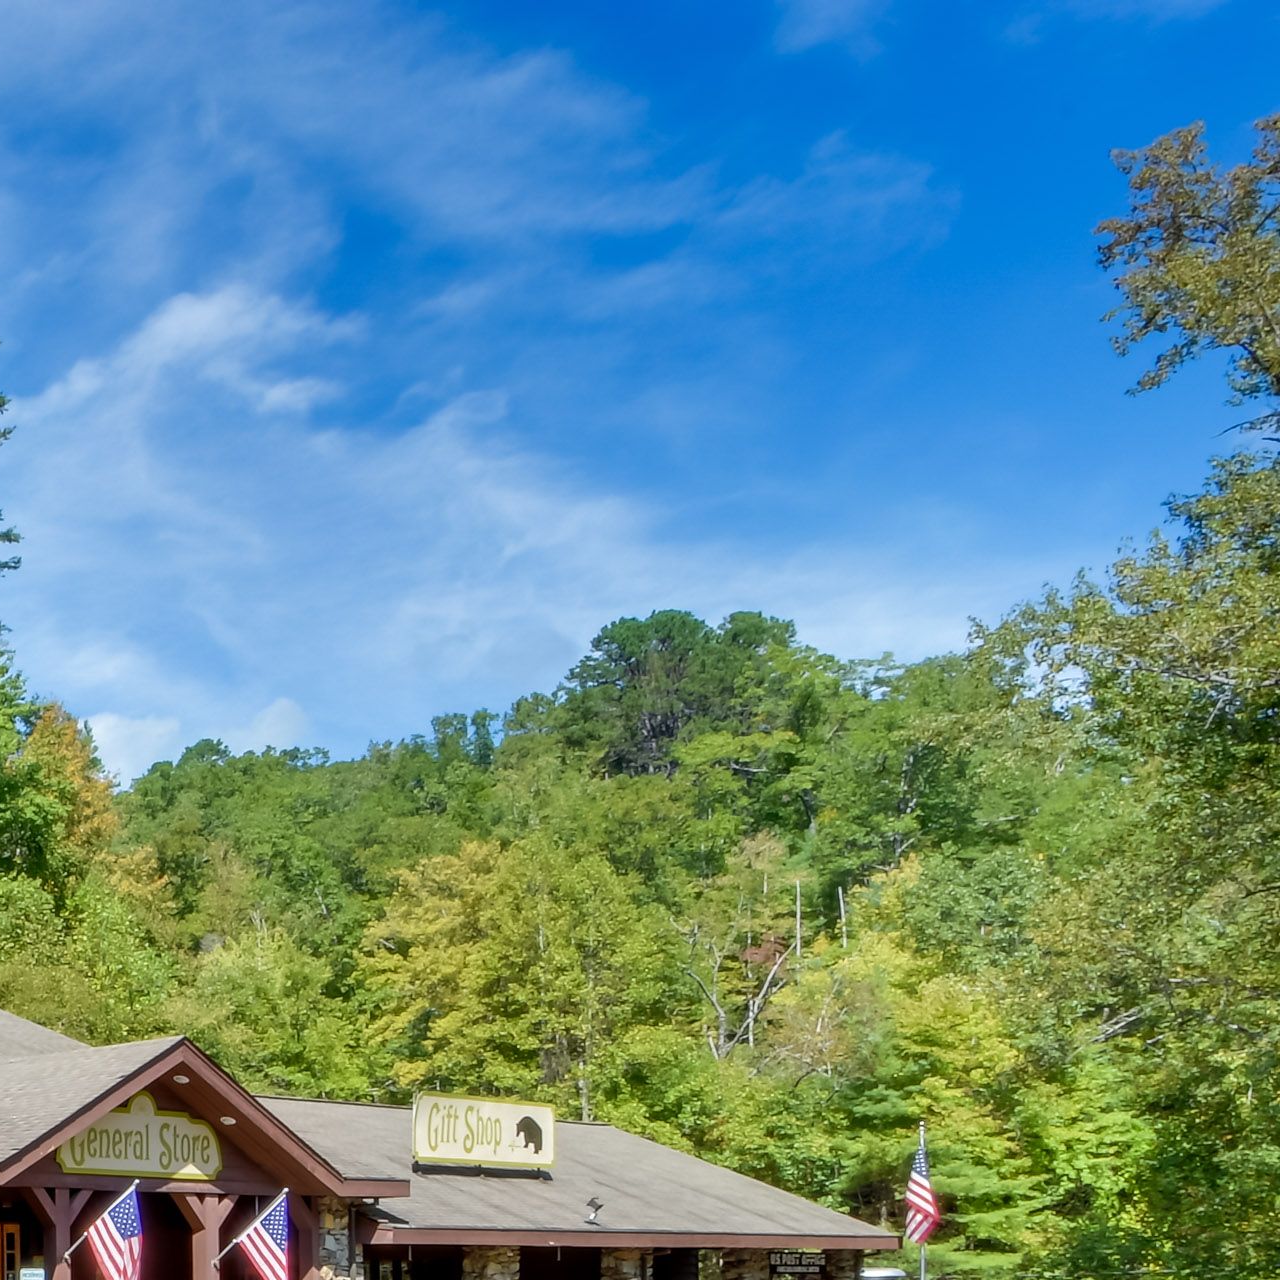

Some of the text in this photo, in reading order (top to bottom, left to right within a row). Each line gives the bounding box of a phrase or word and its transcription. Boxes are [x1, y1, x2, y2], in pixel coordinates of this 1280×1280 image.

[69, 1122, 211, 1170] General Store
[427, 1102, 502, 1155] Gift Shop
